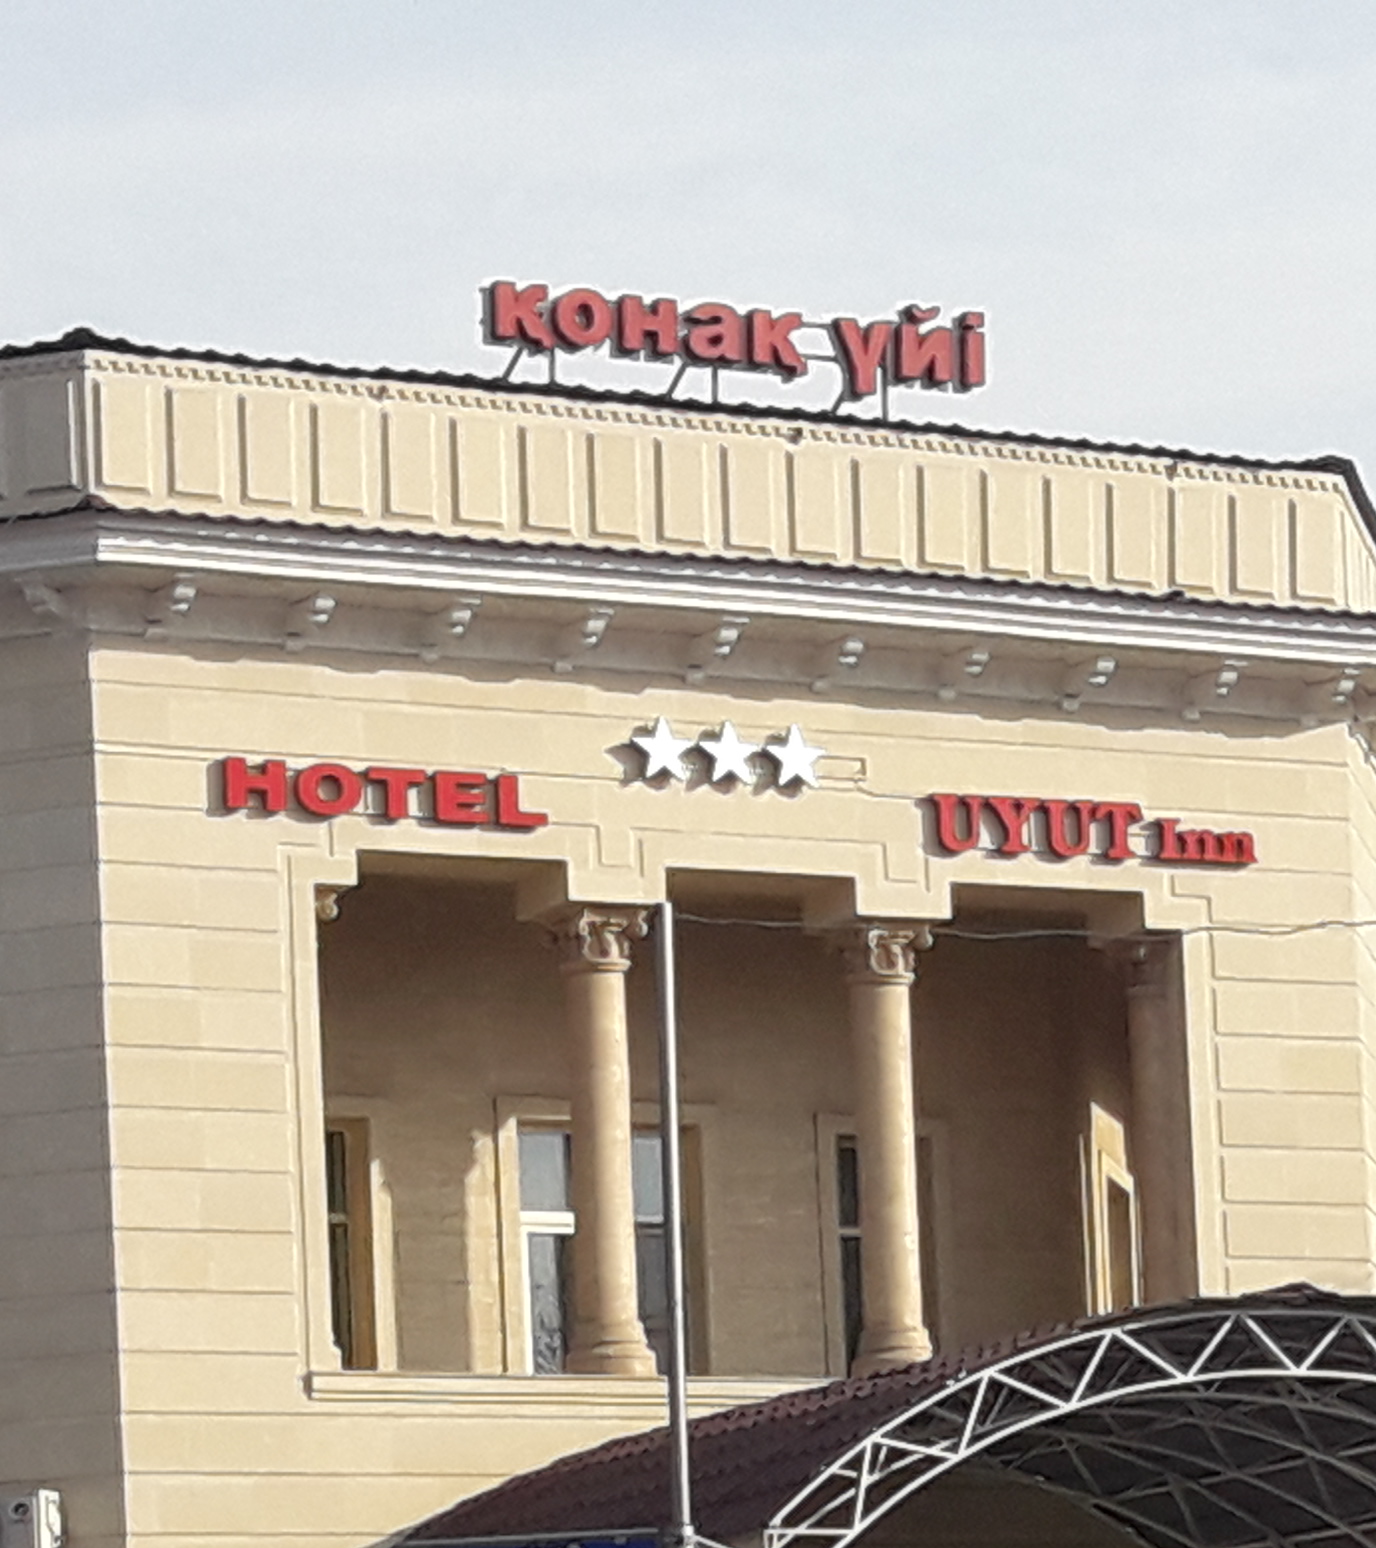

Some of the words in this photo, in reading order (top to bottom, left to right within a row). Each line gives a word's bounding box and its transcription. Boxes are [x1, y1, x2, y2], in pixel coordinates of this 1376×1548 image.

[834, 304, 985, 395] үйі
[225, 757, 548, 828] HOTEL
[930, 793, 1144, 860] UYUT
[1158, 817, 1258, 864] Inn
